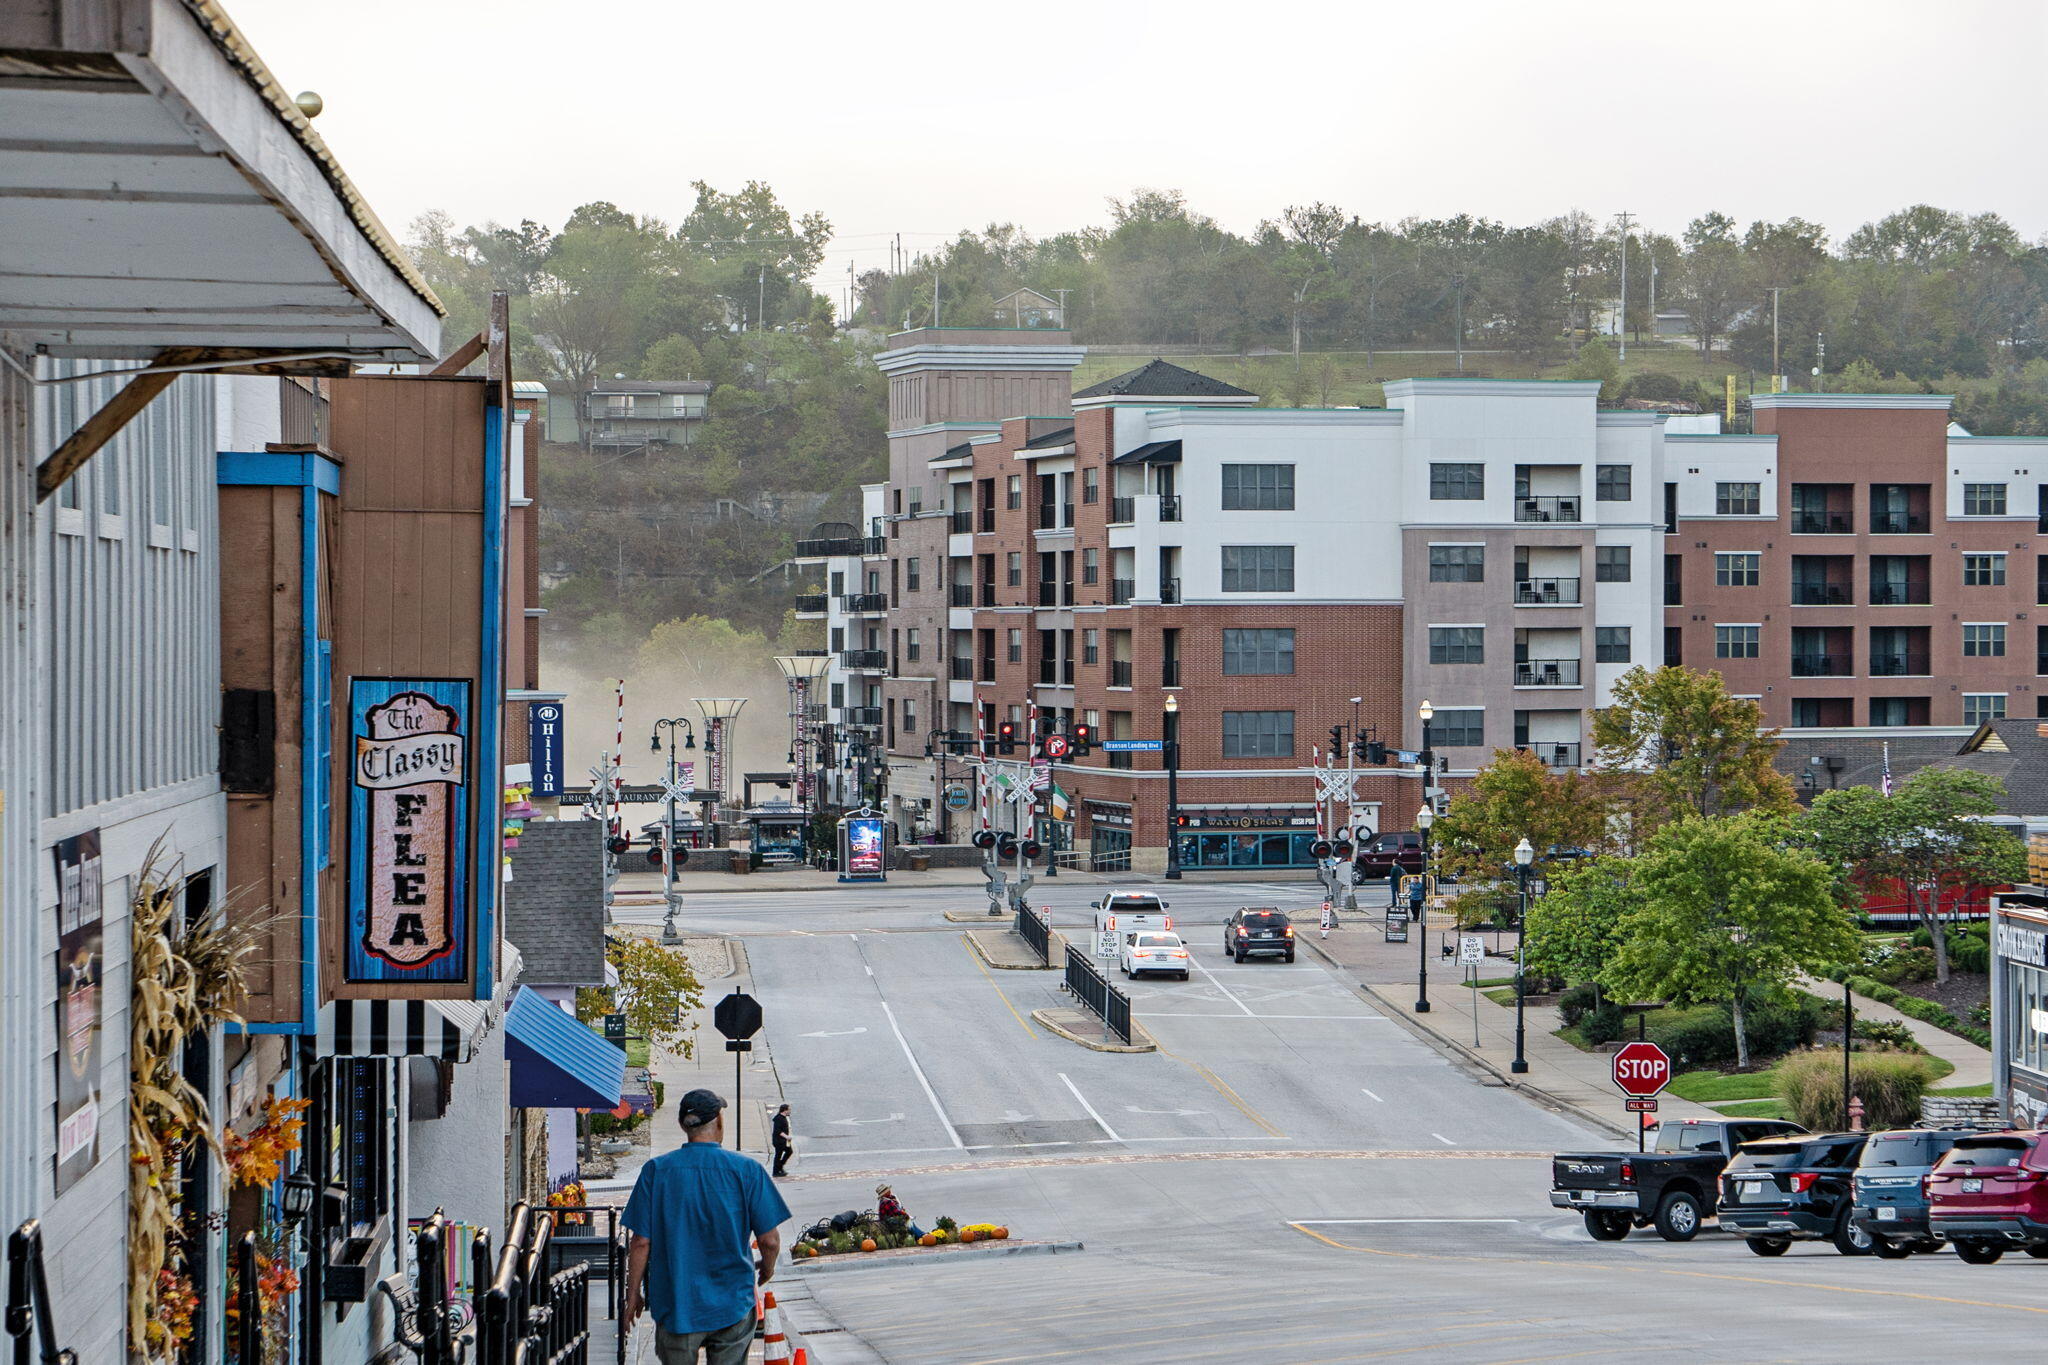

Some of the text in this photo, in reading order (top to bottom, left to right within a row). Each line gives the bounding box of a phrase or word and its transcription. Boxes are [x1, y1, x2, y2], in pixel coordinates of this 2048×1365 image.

[386, 709, 422, 730] The
[542, 723, 554, 792] Hilton
[1128, 742, 1148, 750] Landing
[362, 742, 457, 781] Classy
[606, 793, 661, 802] ESTAURANT
[660, 776, 688, 805] CROSSING
[1008, 773, 1037, 802] CROSSING
[1318, 772, 1347, 800] CROSSING
[1305, 817, 1315, 825] PUB
[389, 794, 428, 946] FLEA
[1618, 1059, 1666, 1079] STOP
[1568, 1164, 1605, 1174] RAM
